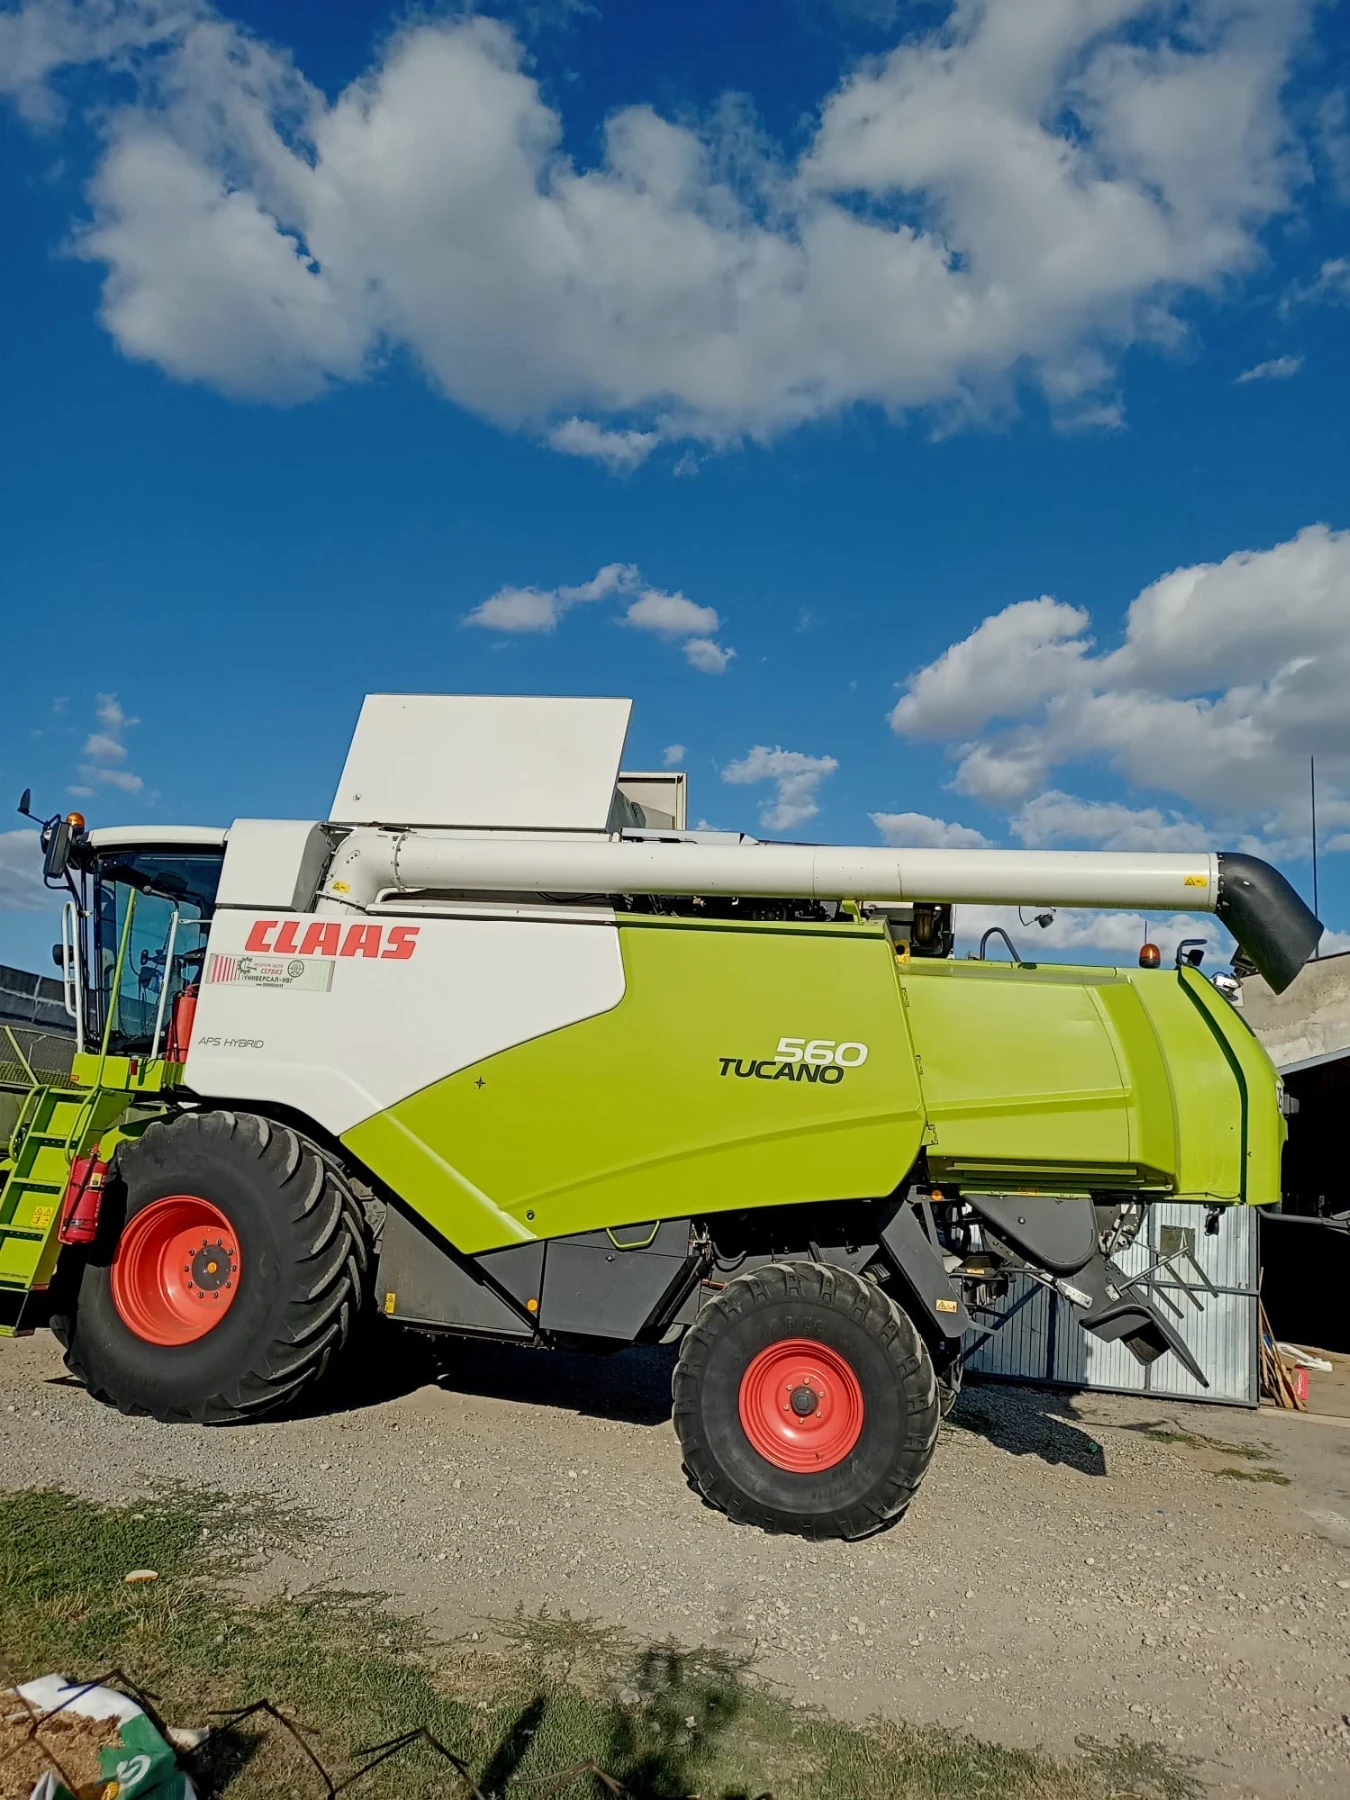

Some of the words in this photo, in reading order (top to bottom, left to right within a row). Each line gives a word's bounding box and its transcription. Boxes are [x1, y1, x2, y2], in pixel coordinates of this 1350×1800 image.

[244, 920, 421, 960] CLAAS
[198, 1037, 222, 1046] APS
[223, 1038, 265, 1049] HYBRID
[773, 1037, 869, 1068] 560
[719, 1057, 845, 1085] TUCANO
